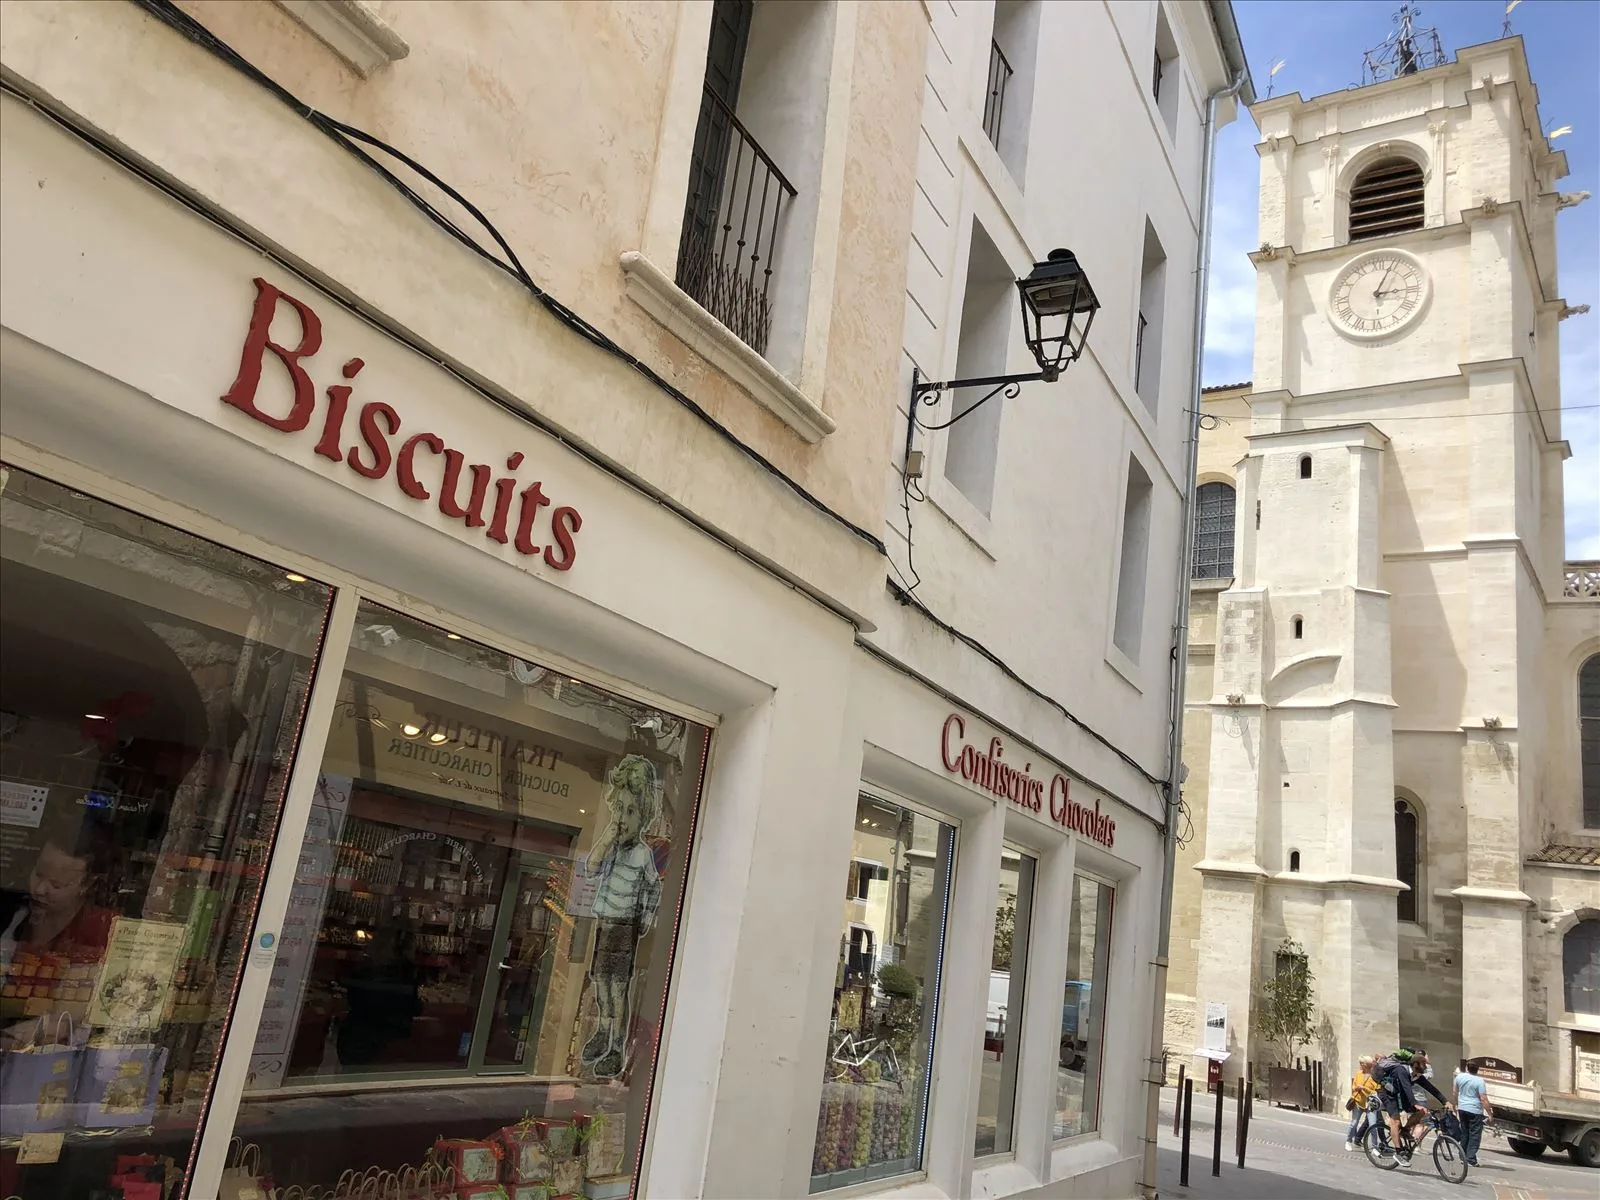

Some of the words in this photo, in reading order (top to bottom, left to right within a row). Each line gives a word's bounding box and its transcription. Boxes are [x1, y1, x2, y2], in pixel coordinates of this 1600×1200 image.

[220, 277, 582, 571] Biscuits
[942, 713, 1043, 813] Confiseries
[1050, 773, 1115, 848] Chocolats
